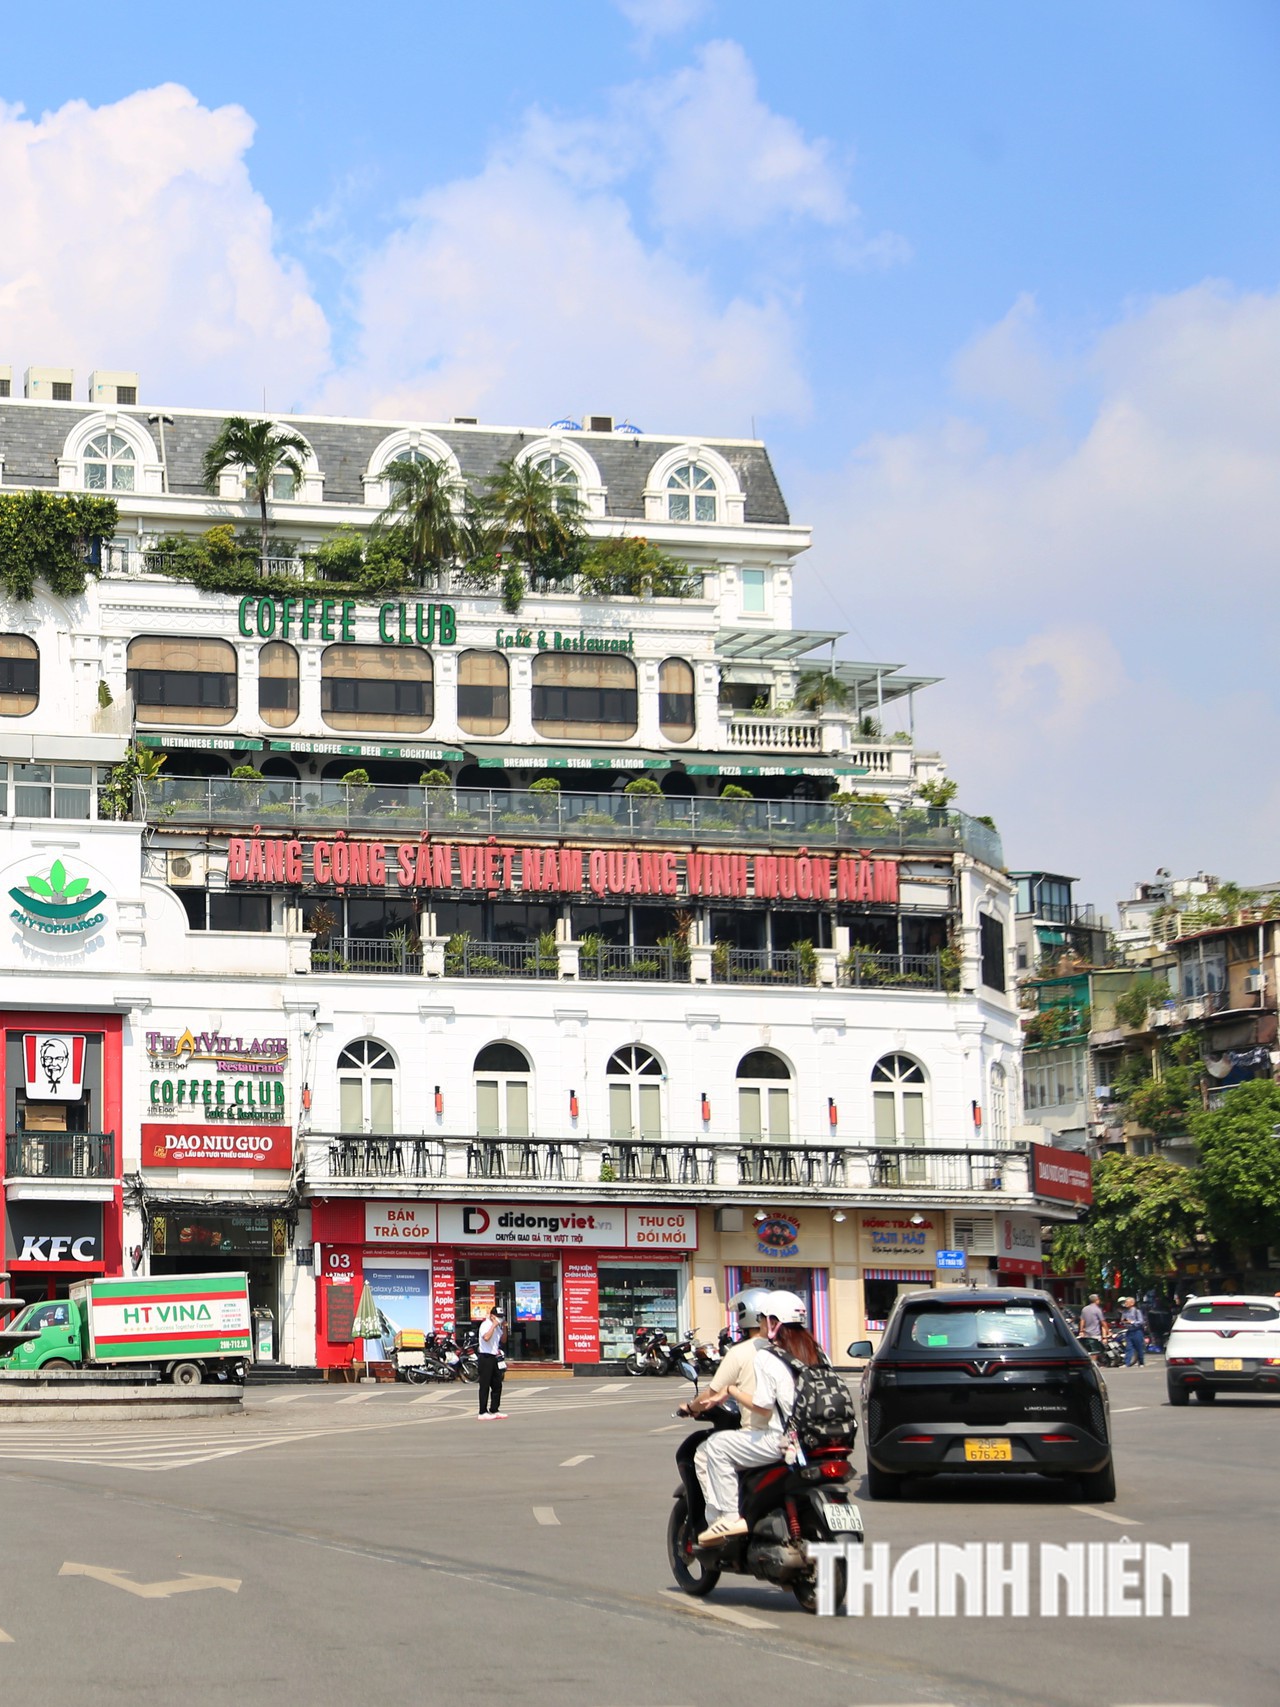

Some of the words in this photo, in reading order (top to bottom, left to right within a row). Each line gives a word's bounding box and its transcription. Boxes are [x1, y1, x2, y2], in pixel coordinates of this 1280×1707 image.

[238, 596, 357, 642] COFFEE
[378, 602, 457, 645] CLUB
[496, 628, 533, 648] Café
[538, 629, 548, 649] &
[554, 630, 634, 652] Restaurant
[161, 737, 211, 749] VIETNAMESE
[213, 739, 234, 750] FOOD
[290, 742, 311, 752] EGGS
[313, 743, 342, 754] COFFEE
[360, 745, 381, 756] BEER
[400, 748, 443, 760] COCKTAILS
[503, 758, 549, 768] BREAKFAST
[567, 758, 592, 768] STEAK
[610, 759, 644, 768] SALMON
[718, 766, 742, 776] PIZZA
[759, 767, 785, 776] PASTA
[229, 824, 303, 884] ĐẢNG
[313, 830, 385, 894] CỘNG
[397, 830, 451, 888] SẢN
[458, 836, 515, 898] VIỆT
[521, 848, 582, 892] NAM
[589, 850, 677, 899] QUANG
[686, 853, 747, 898] VINH
[754, 847, 830, 901] MUÔN
[838, 849, 900, 903] NĂM
[10, 909, 104, 934] PHYTOPHARCO
[217, 1060, 284, 1073] Restaurants
[150, 1079, 225, 1104] COFFEE
[234, 1080, 285, 1106] CLUB
[227, 1107, 236, 1119] &
[165, 1134, 200, 1150] DAO
[203, 1136, 234, 1150] NIU
[236, 1137, 273, 1151] GUO
[387, 1208, 415, 1221] BÁN
[638, 1216, 665, 1227] THU
[667, 1214, 685, 1227] CŨ
[401, 1224, 430, 1239] GÓP
[662, 1230, 686, 1244] MỚI
[18, 1236, 96, 1262] KFC
[329, 1254, 350, 1268] 03
[369, 1285, 391, 1294] Galaxy
[435, 1296, 453, 1306] Apple
[175, 1323, 195, 1331] Together
[978, 1439, 997, 1449] 29E
[970, 1450, 1007, 1460] 676.23
